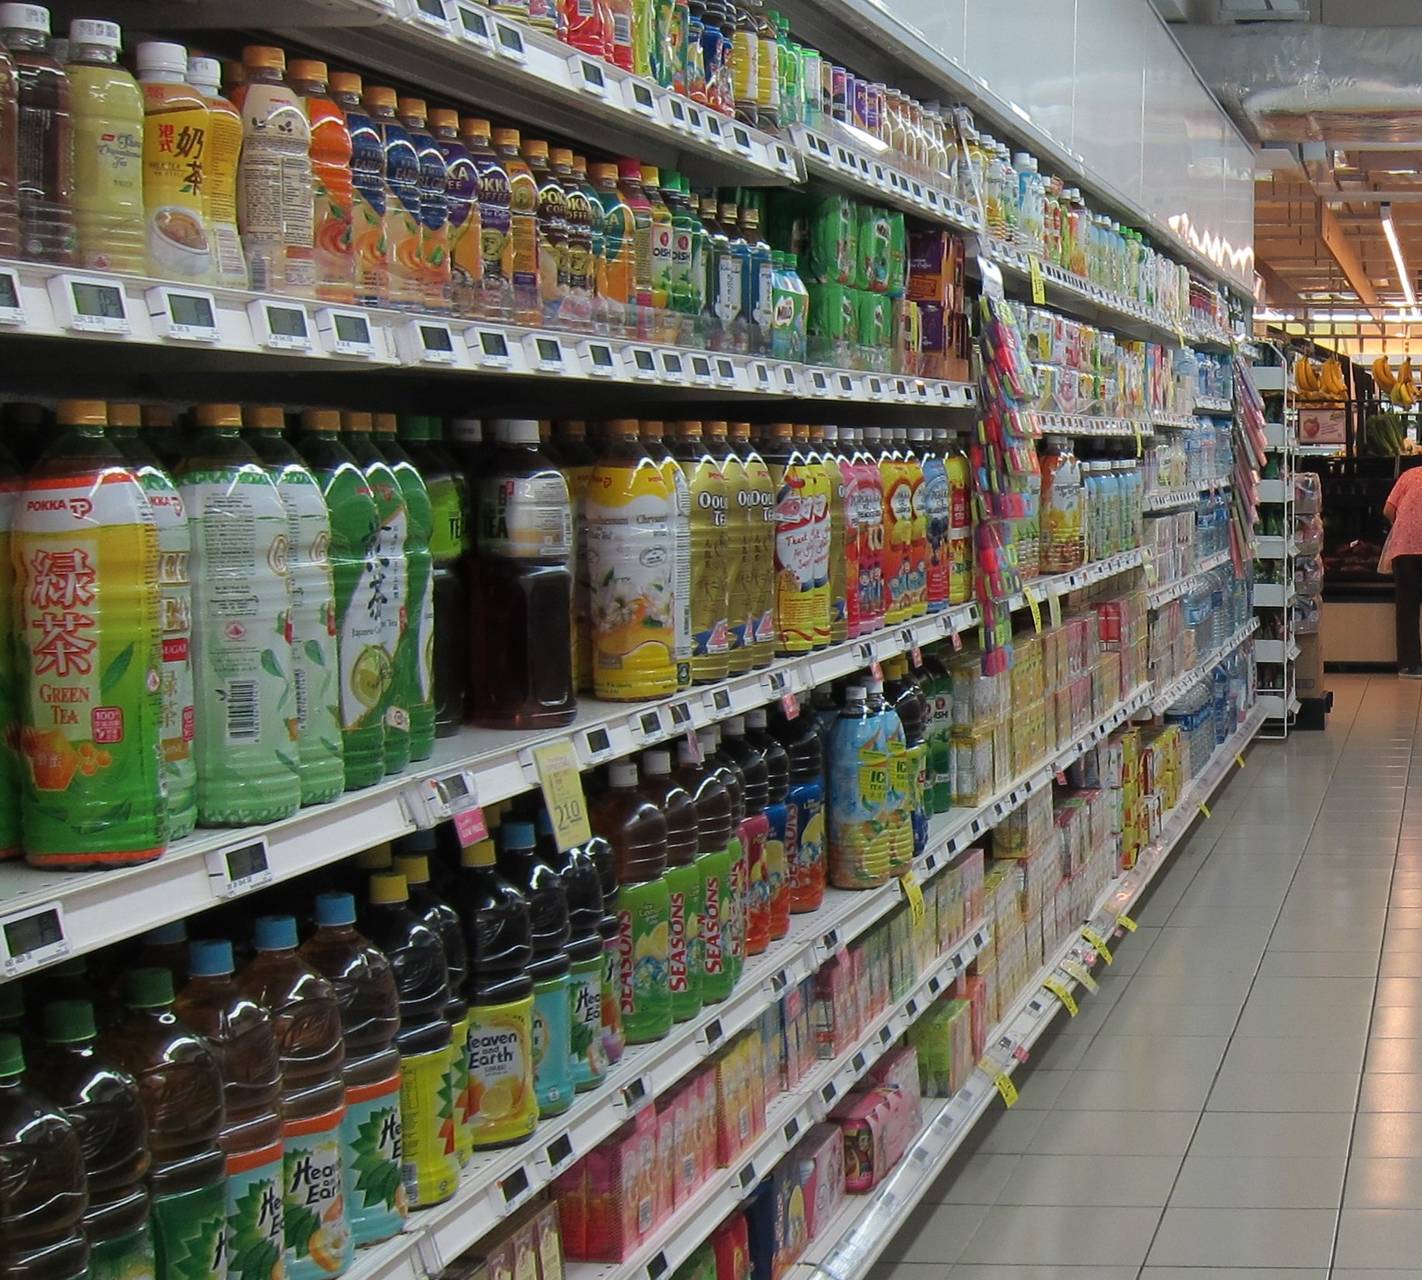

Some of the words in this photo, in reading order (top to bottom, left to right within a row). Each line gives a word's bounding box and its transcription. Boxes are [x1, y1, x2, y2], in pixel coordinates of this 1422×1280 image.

[174, 125, 204, 196] 奶茶
[652, 246, 672, 257] OISH
[672, 251, 690, 261] OISH
[27, 500, 67, 512] POKKA
[39, 684, 90, 703] GREEN
[51, 705, 79, 724] TEA
[705, 874, 723, 975] SEASONS
[668, 891, 688, 993] SEASONS
[468, 1050, 513, 1070] Earth
